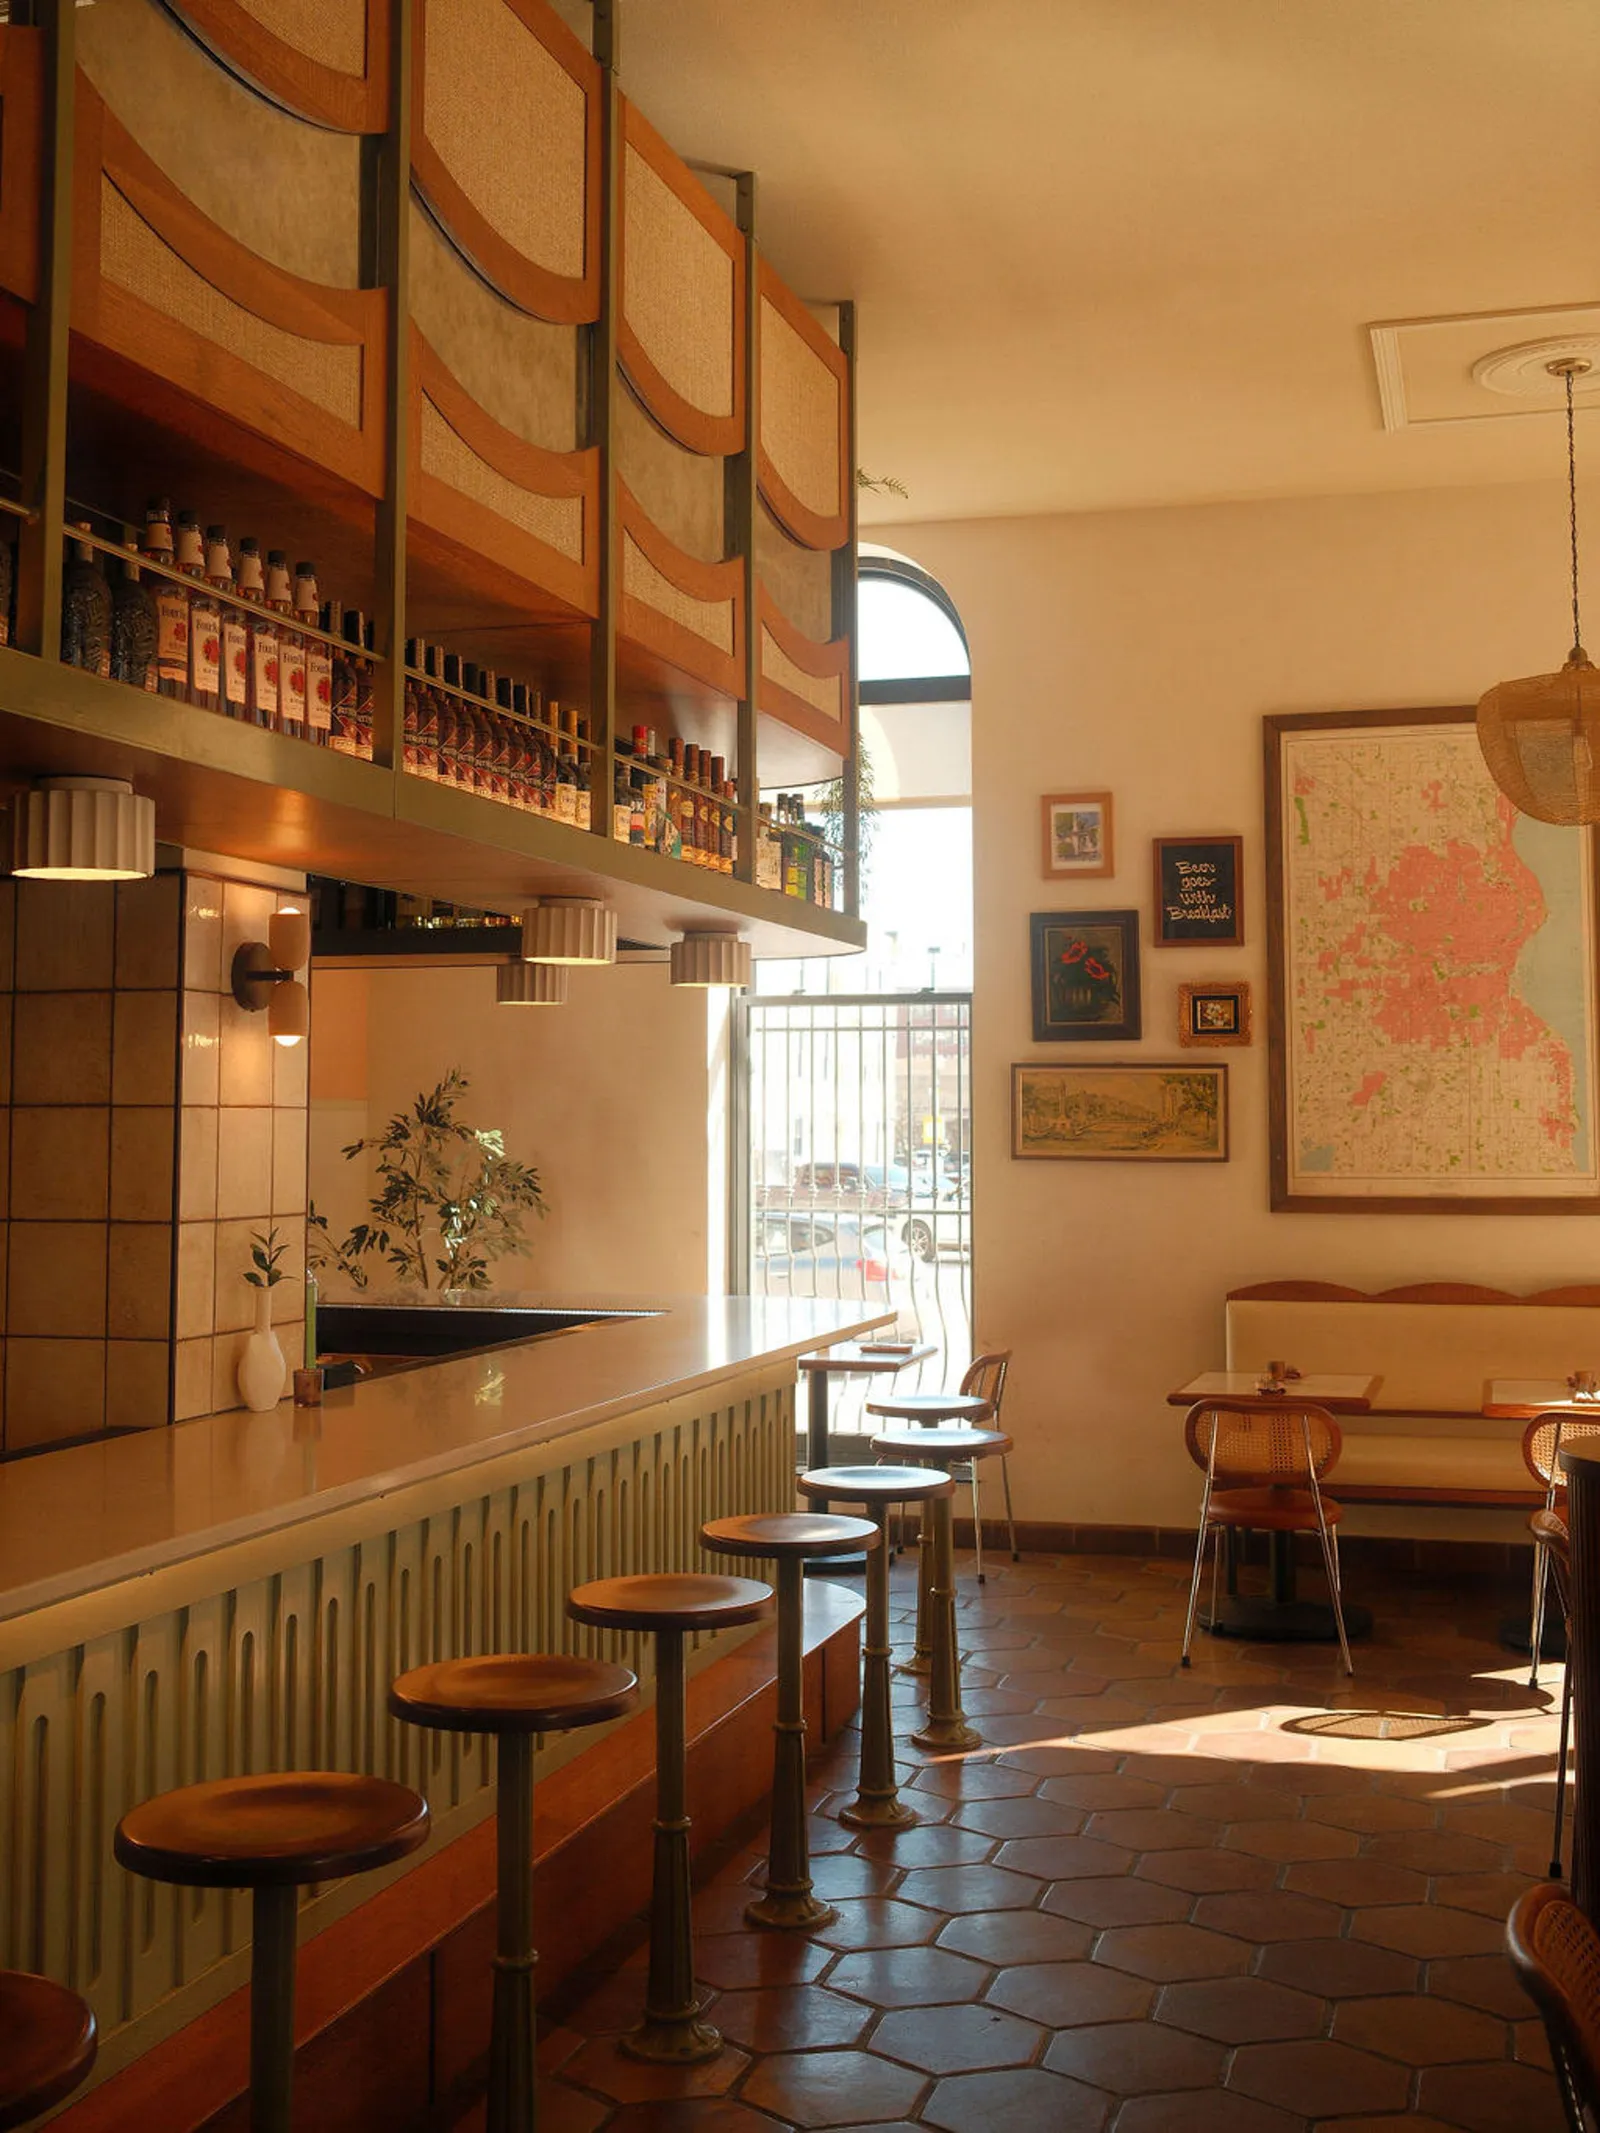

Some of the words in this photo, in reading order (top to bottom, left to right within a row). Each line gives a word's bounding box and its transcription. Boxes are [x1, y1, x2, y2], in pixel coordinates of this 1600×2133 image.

[1175, 861, 1217, 874] Beer
[1181, 877, 1216, 891] goes
[1179, 890, 1216, 904] with
[1166, 904, 1232, 923] Breakfast
